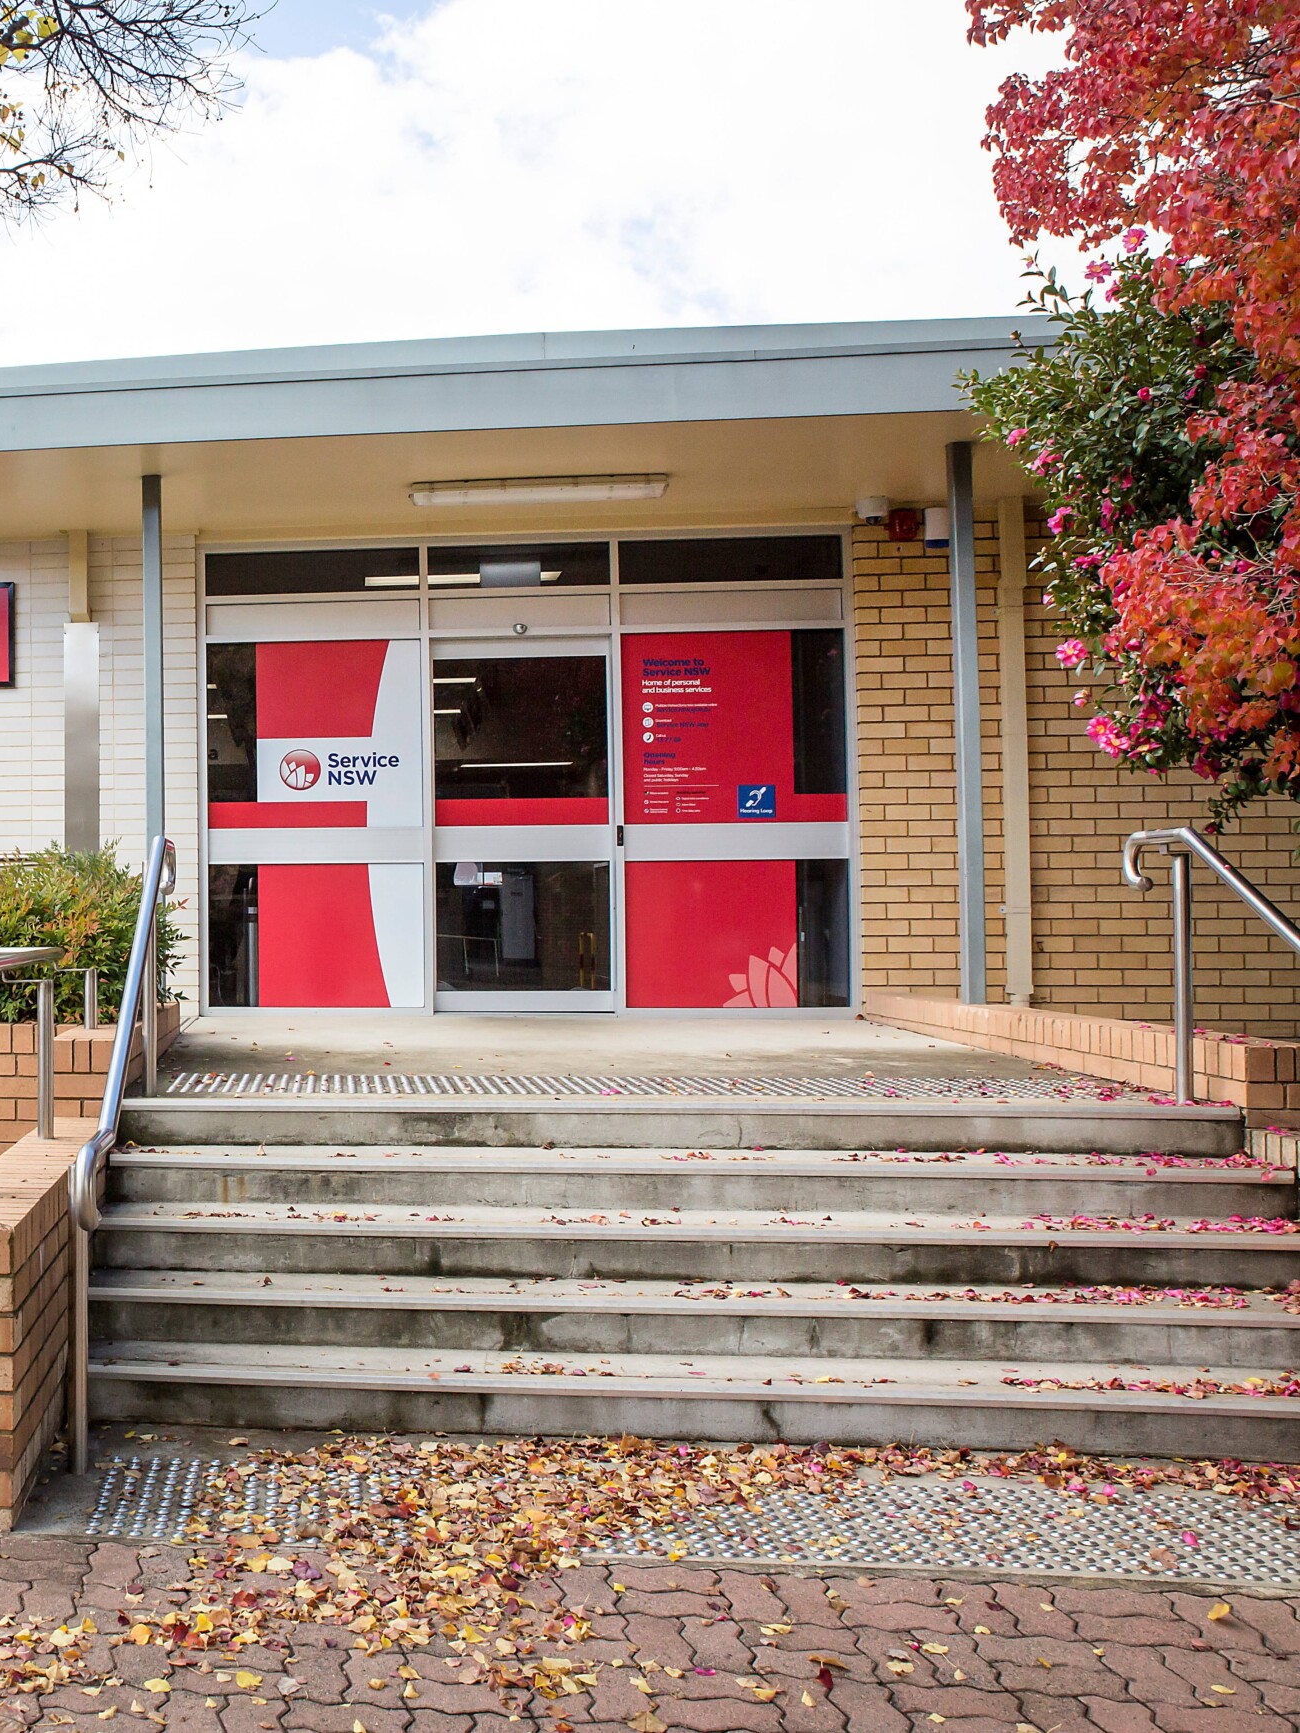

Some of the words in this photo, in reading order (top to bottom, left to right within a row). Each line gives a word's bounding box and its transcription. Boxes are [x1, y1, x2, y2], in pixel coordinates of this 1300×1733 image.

[642, 658, 690, 667] Welcome
[694, 658, 704, 666] to
[642, 668, 682, 676] Service
[684, 667, 711, 675] NSW
[672, 679, 700, 687] personal
[328, 752, 400, 768] Service
[328, 770, 377, 785] NSW
